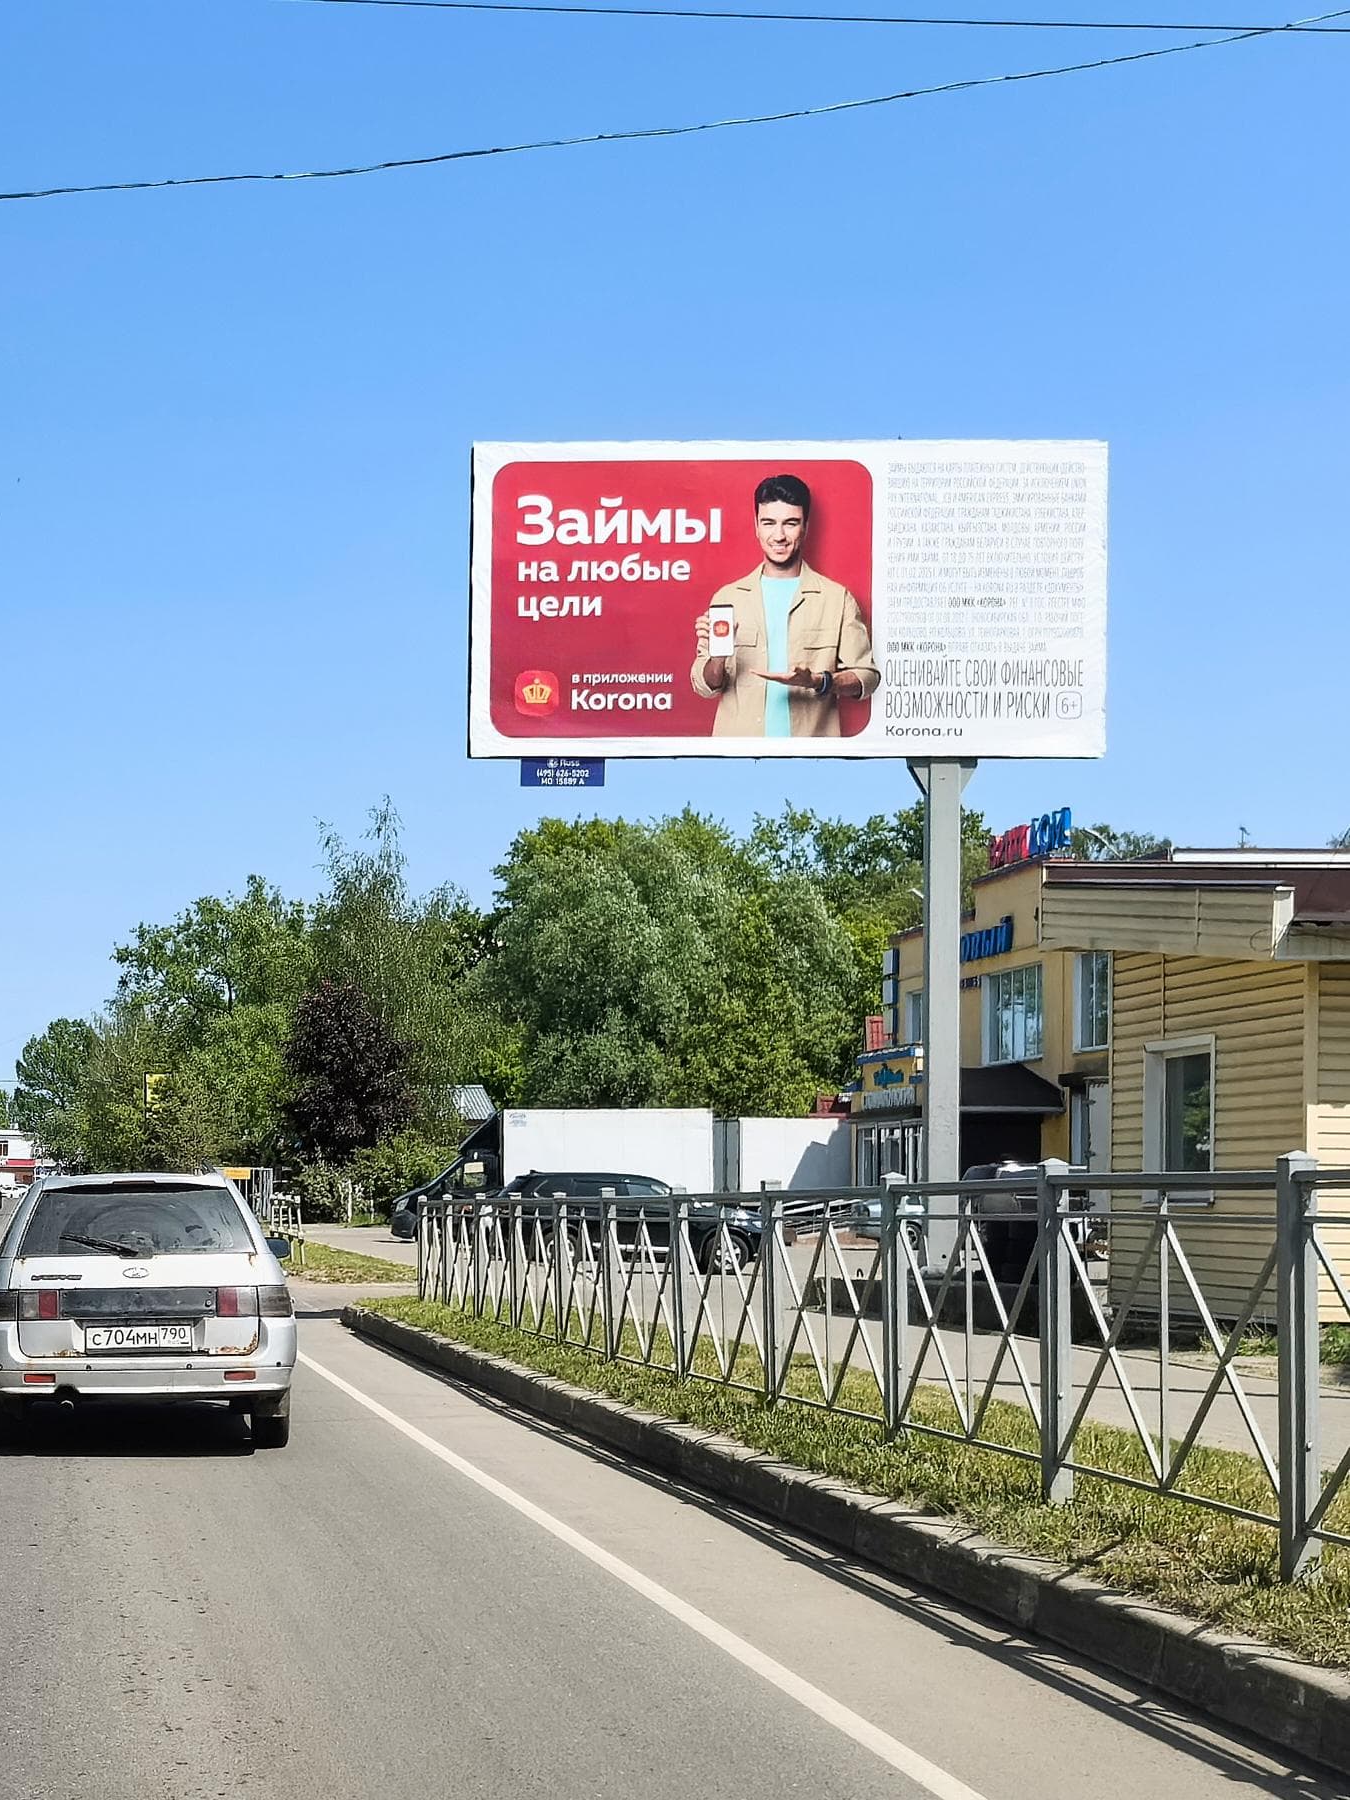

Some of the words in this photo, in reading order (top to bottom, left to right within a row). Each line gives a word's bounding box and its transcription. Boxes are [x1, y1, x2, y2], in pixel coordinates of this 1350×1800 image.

[516, 494, 722, 546] Займы
[517, 560, 560, 582] на
[567, 552, 692, 582] любые
[517, 594, 603, 621] цели
[571, 674, 580, 684] в
[583, 673, 673, 687] приложении
[885, 654, 962, 688] ОЦЕНИВАЙТЕ
[965, 659, 997, 688] СВОИ
[1000, 659, 1084, 688] ФИНАНСОВЫЕ
[571, 688, 672, 711] Korona
[885, 690, 988, 719] ВОЗМОЖНОСТИ
[993, 691, 1001, 719] И
[1006, 691, 1050, 719] РИСКИ
[1061, 697, 1079, 715] 6+
[885, 725, 963, 738] Korona.ru
[960, 914, 1014, 964] ОВЫЙ
[161, 1327, 186, 1340] 790
